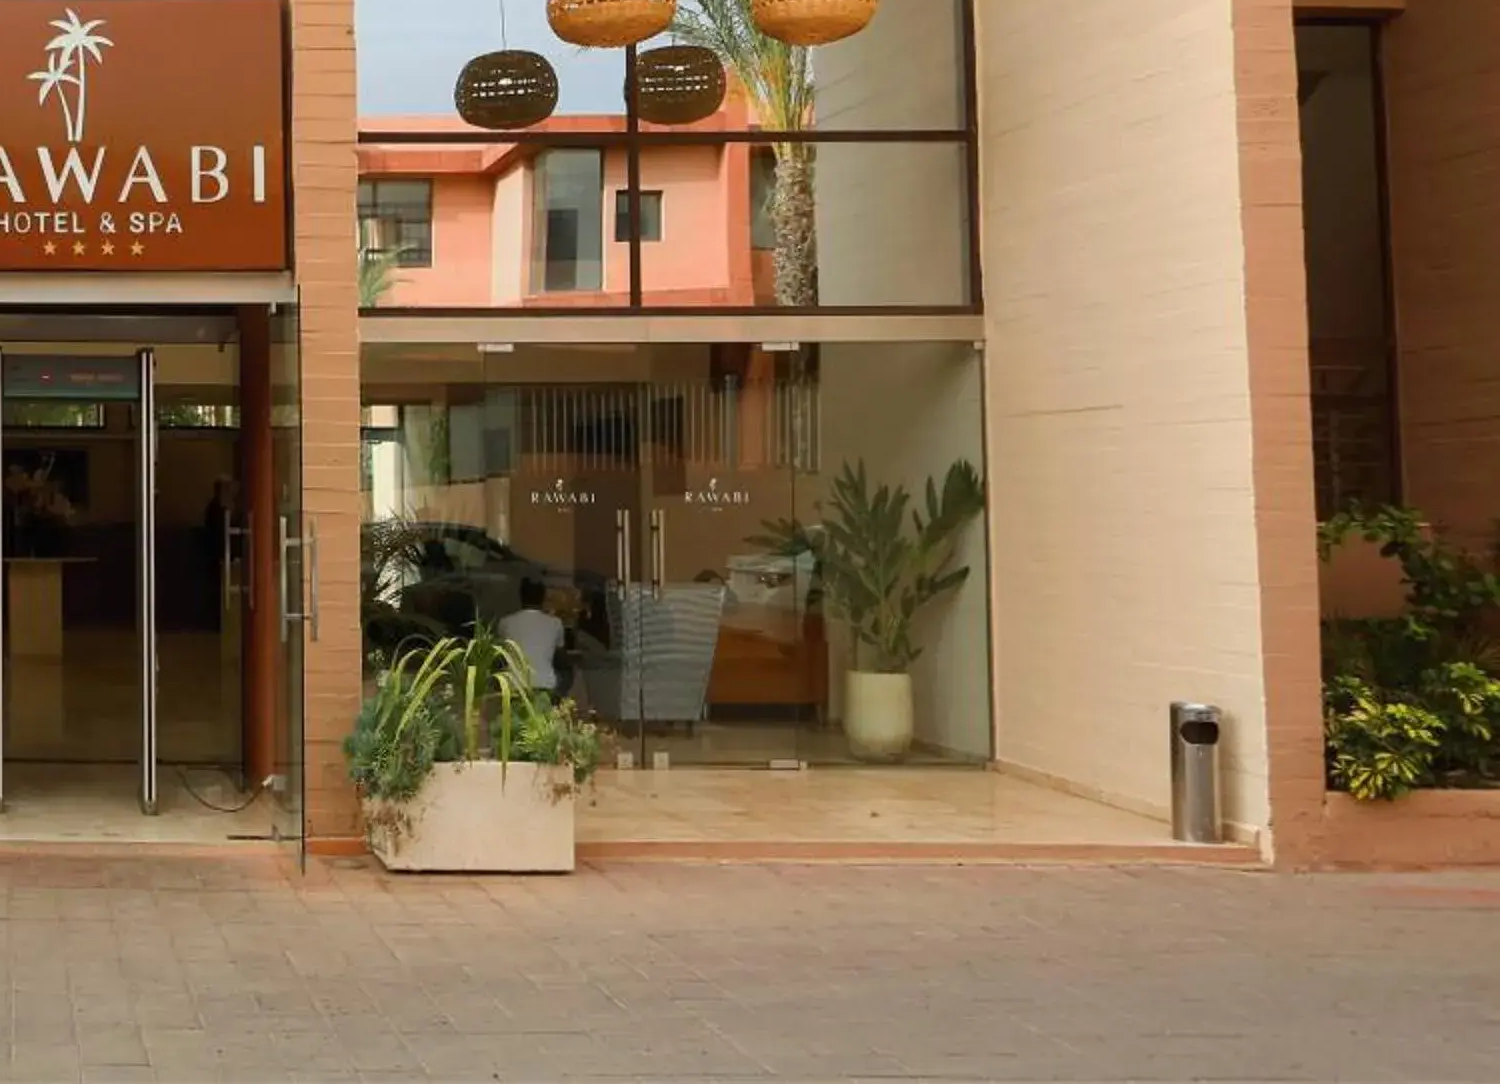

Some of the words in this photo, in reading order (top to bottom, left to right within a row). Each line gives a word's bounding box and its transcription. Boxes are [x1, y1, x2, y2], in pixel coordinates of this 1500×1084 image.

[99, 211, 117, 234] &
[129, 212, 183, 234] SPA
[531, 491, 596, 504] RAWABI
[684, 491, 750, 504] RAWABI
